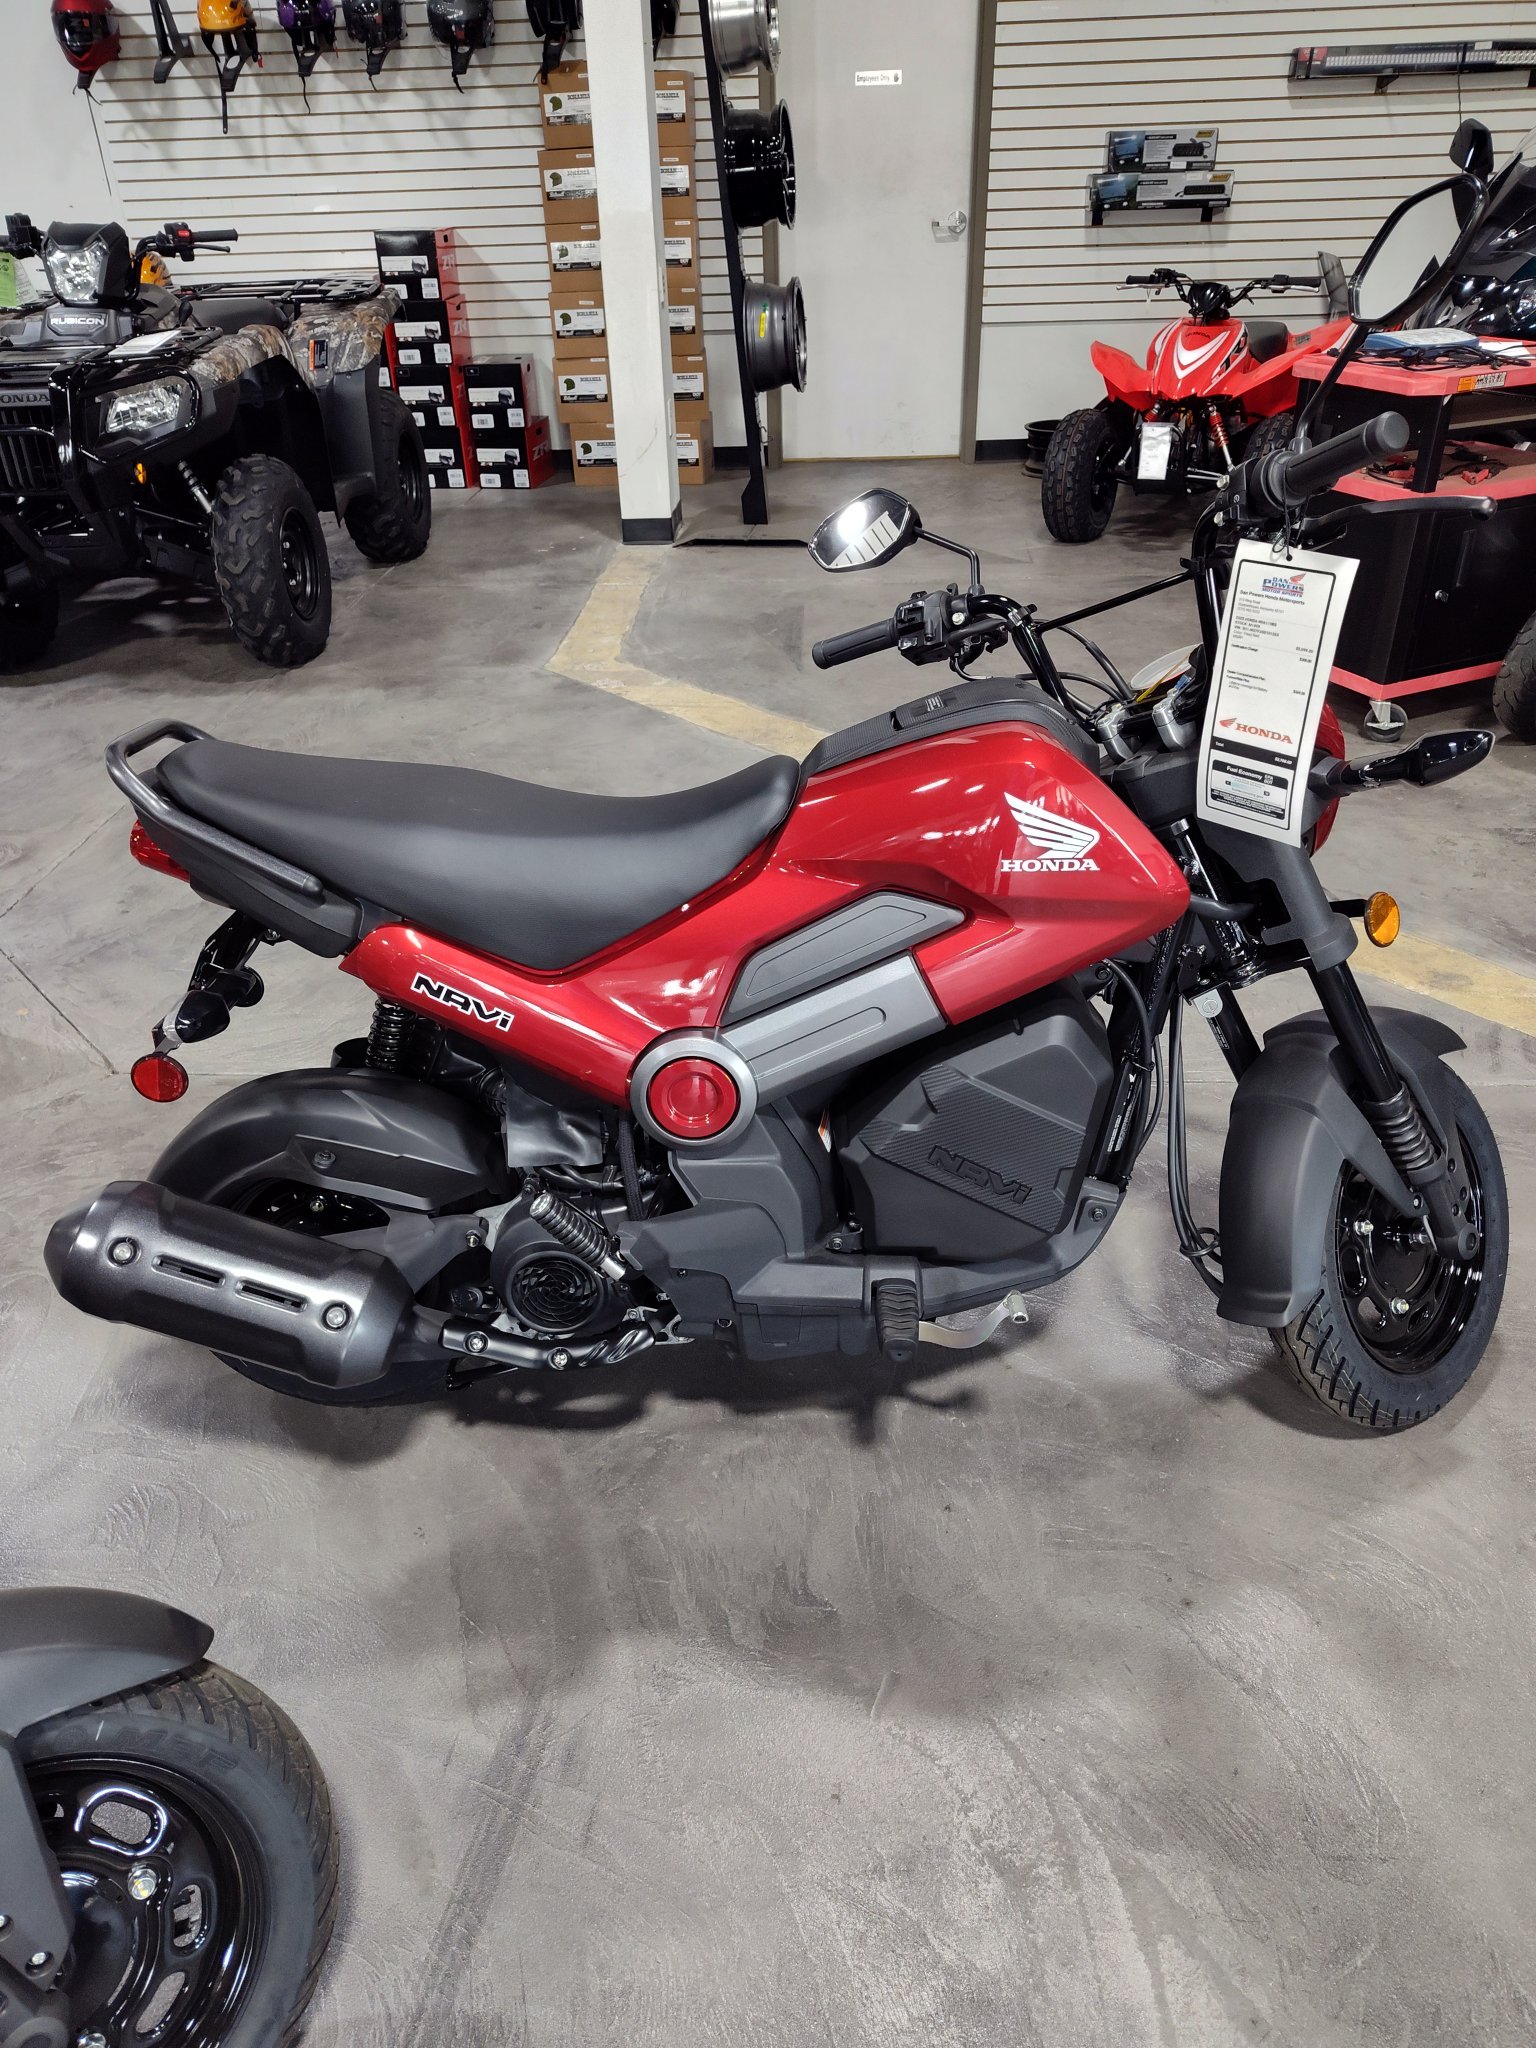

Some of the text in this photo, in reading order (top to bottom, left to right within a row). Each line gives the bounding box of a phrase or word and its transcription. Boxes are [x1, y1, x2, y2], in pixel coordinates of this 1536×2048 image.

[856, 74, 890, 84] Employees Only
[50, 317, 105, 326] RUBICON
[0, 393, 50, 404] ONDA
[1262, 578, 1304, 592] POWERS
[1272, 576, 1289, 584] DAN
[1262, 588, 1303, 598] MOTOR SPORTS
[1279, 596, 1305, 606] Motorsports
[1236, 722, 1294, 744] HONDA
[1226, 766, 1262, 780] Fuel Economy
[1000, 858, 1100, 872] HONDA
